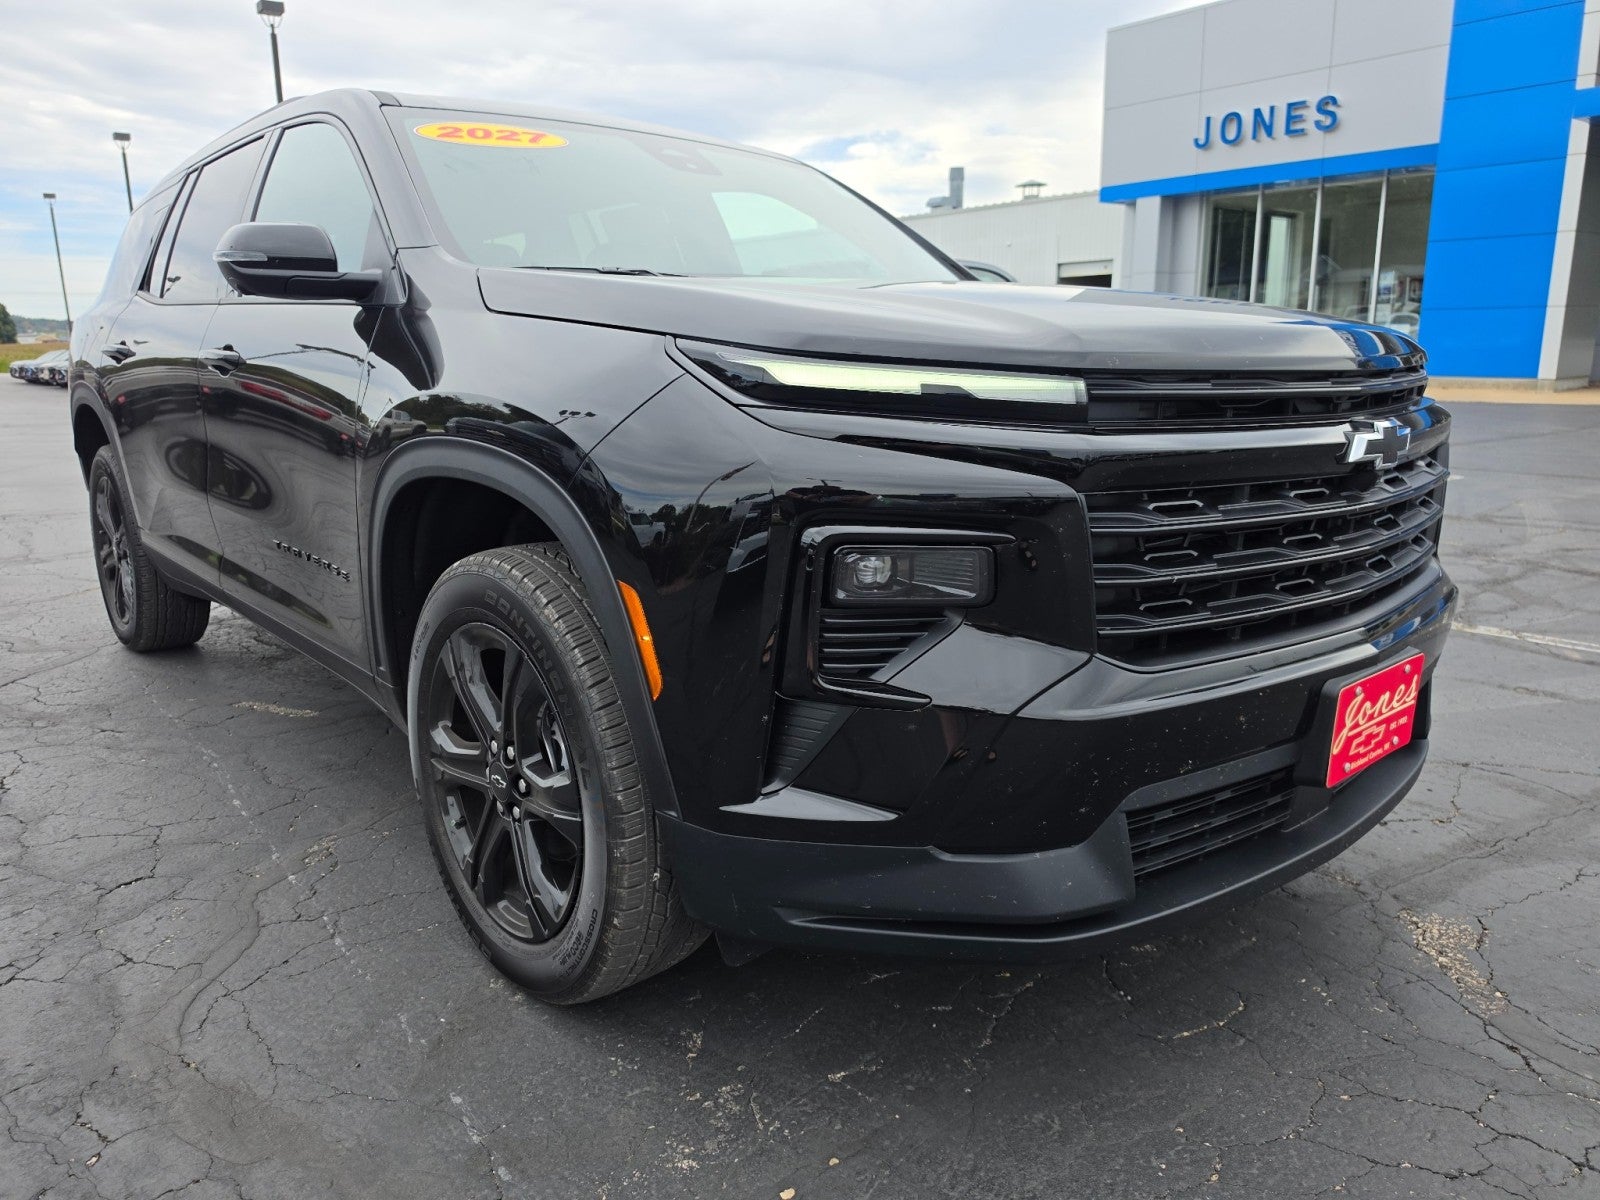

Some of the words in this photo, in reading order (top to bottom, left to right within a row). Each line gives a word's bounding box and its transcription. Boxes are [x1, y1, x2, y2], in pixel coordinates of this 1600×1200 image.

[436, 126, 548, 144] 2027
[1193, 95, 1340, 149] JONES
[1332, 674, 1418, 755] Jones
